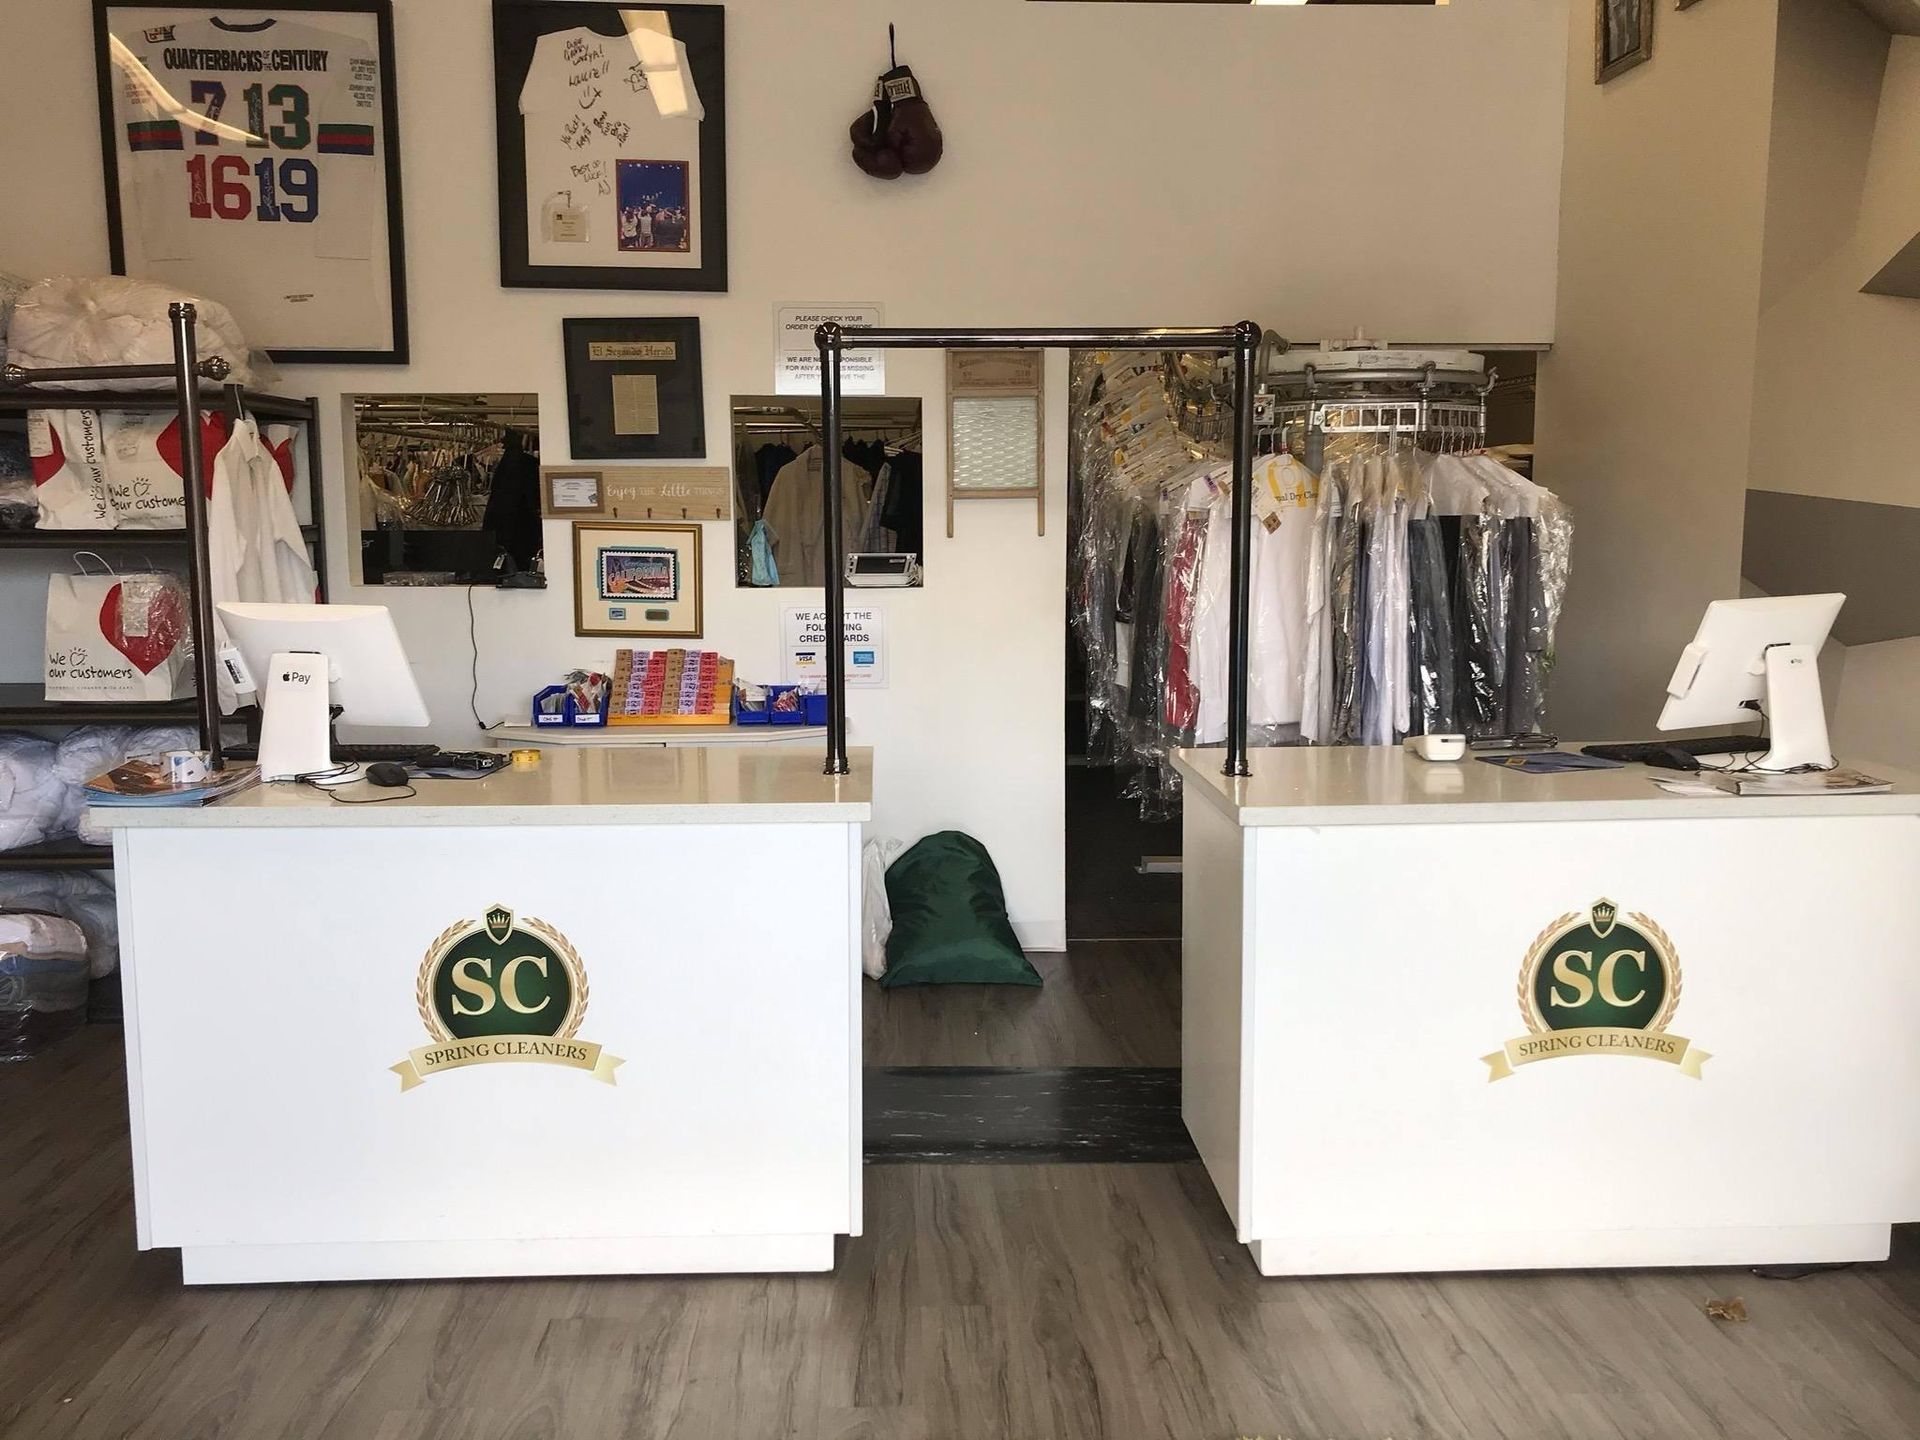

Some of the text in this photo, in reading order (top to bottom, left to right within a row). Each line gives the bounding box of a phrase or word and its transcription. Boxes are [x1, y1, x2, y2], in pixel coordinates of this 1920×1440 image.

[164, 48, 263, 71] QUARTERBACKS
[272, 50, 328, 71] CENTURY
[190, 80, 227, 146] 7
[243, 83, 311, 150] 13
[186, 154, 252, 220] 16
[254, 157, 319, 223] 19
[81, 409, 106, 519] We our customers
[113, 484, 130, 497] We
[606, 484, 636, 499] Enjoy
[660, 483, 691, 498] Little
[136, 495, 186, 510] custome
[796, 613, 810, 621] WE
[853, 612, 872, 620] THE
[844, 634, 870, 642] ARDS
[49, 653, 66, 665] We
[48, 666, 133, 679] our customers
[292, 672, 311, 685] Pay
[451, 956, 551, 1016] SC
[1550, 949, 1646, 1008] SC
[424, 1041, 588, 1066] SPRING CLEANERS
[1519, 1034, 1675, 1056] SPRING CLEANERS
